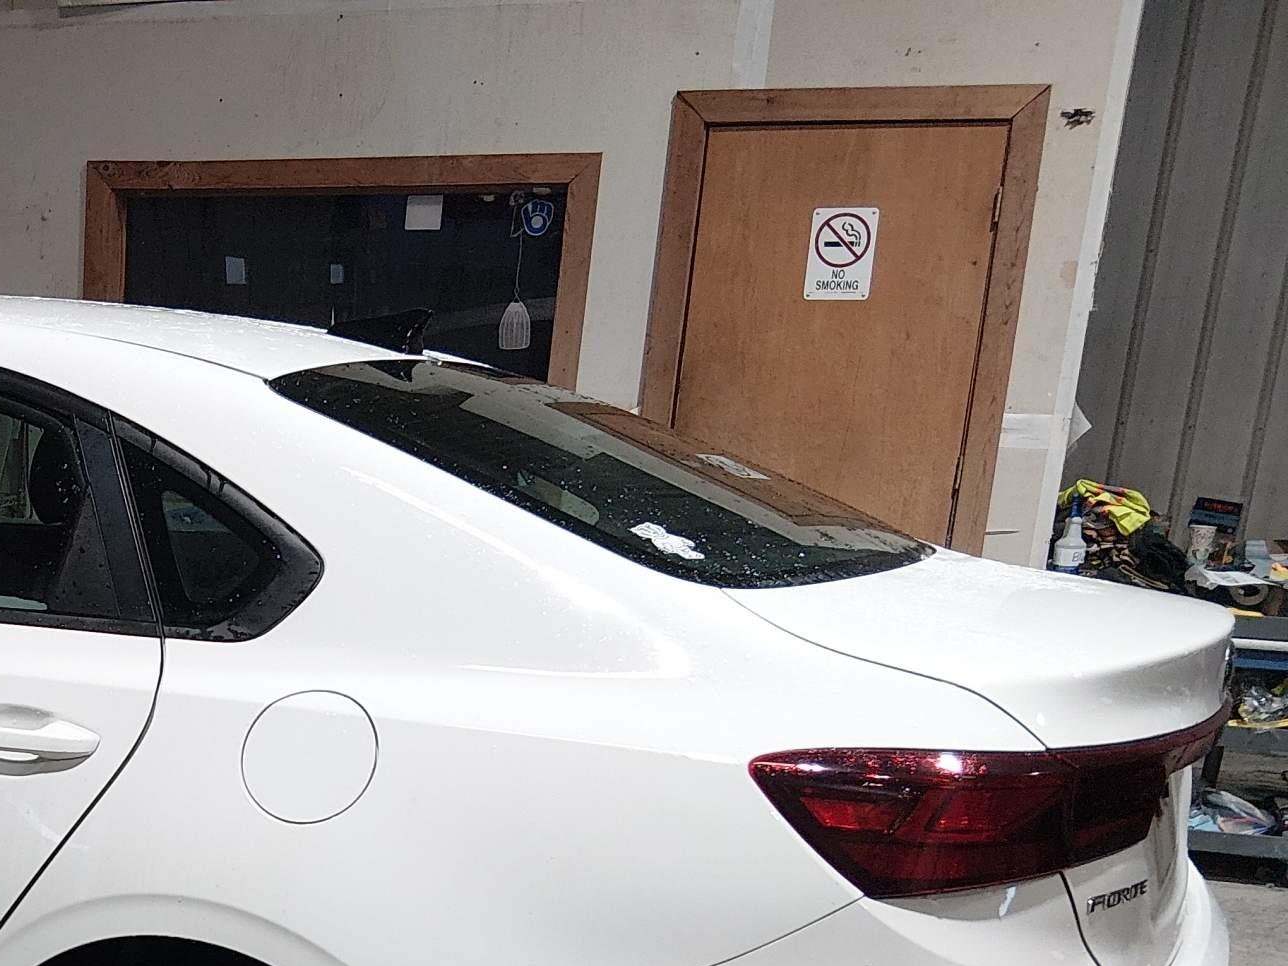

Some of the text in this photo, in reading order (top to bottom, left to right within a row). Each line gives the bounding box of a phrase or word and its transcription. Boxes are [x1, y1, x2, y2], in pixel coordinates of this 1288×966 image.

[831, 269, 846, 280] NO
[815, 280, 860, 291] SMOKING
[1087, 879, 1149, 915] FORTE
